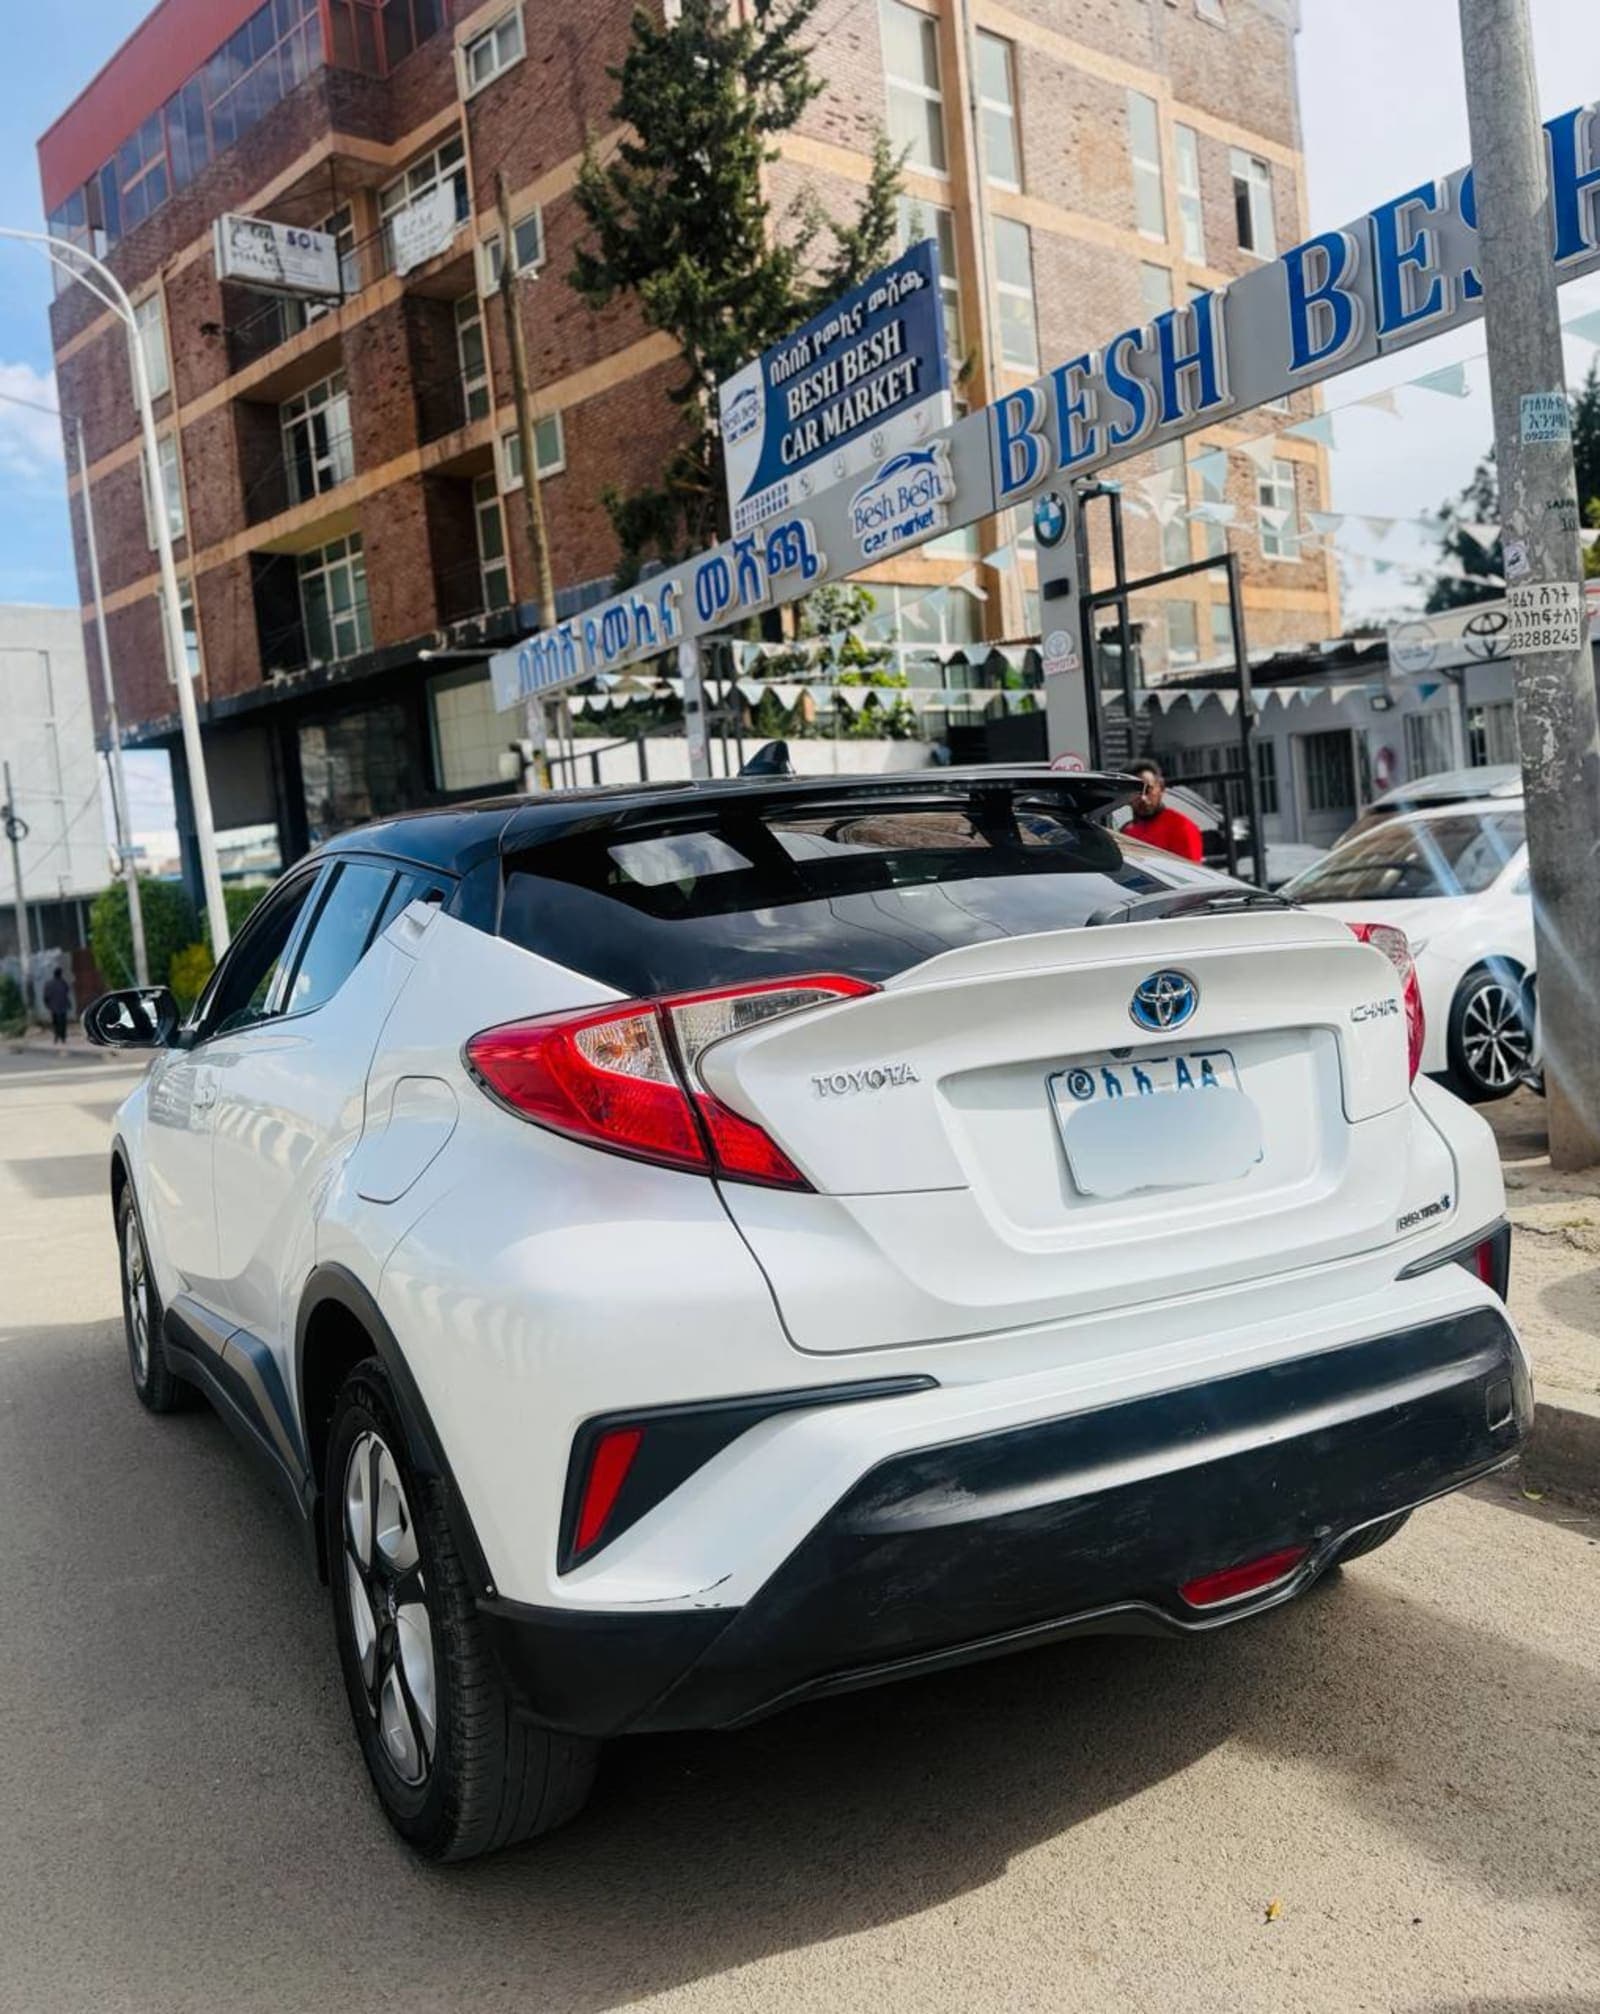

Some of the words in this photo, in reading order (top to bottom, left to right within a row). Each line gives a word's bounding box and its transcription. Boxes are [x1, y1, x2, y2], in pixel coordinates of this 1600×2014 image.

[813, 302, 863, 355] የመኪና
[994, 291, 1224, 494] BESH
[1282, 105, 1600, 371] BEH
[786, 360, 839, 422] BESH
[841, 319, 902, 386] BESH
[780, 418, 825, 465] CAR
[821, 357, 918, 443] MARKET
[853, 493, 895, 534] Besh
[896, 468, 943, 513] Besh
[863, 530, 888, 554] car
[891, 507, 935, 541] market
[584, 582, 675, 667] የመኪና
[811, 1063, 920, 1098] TOYOTA
